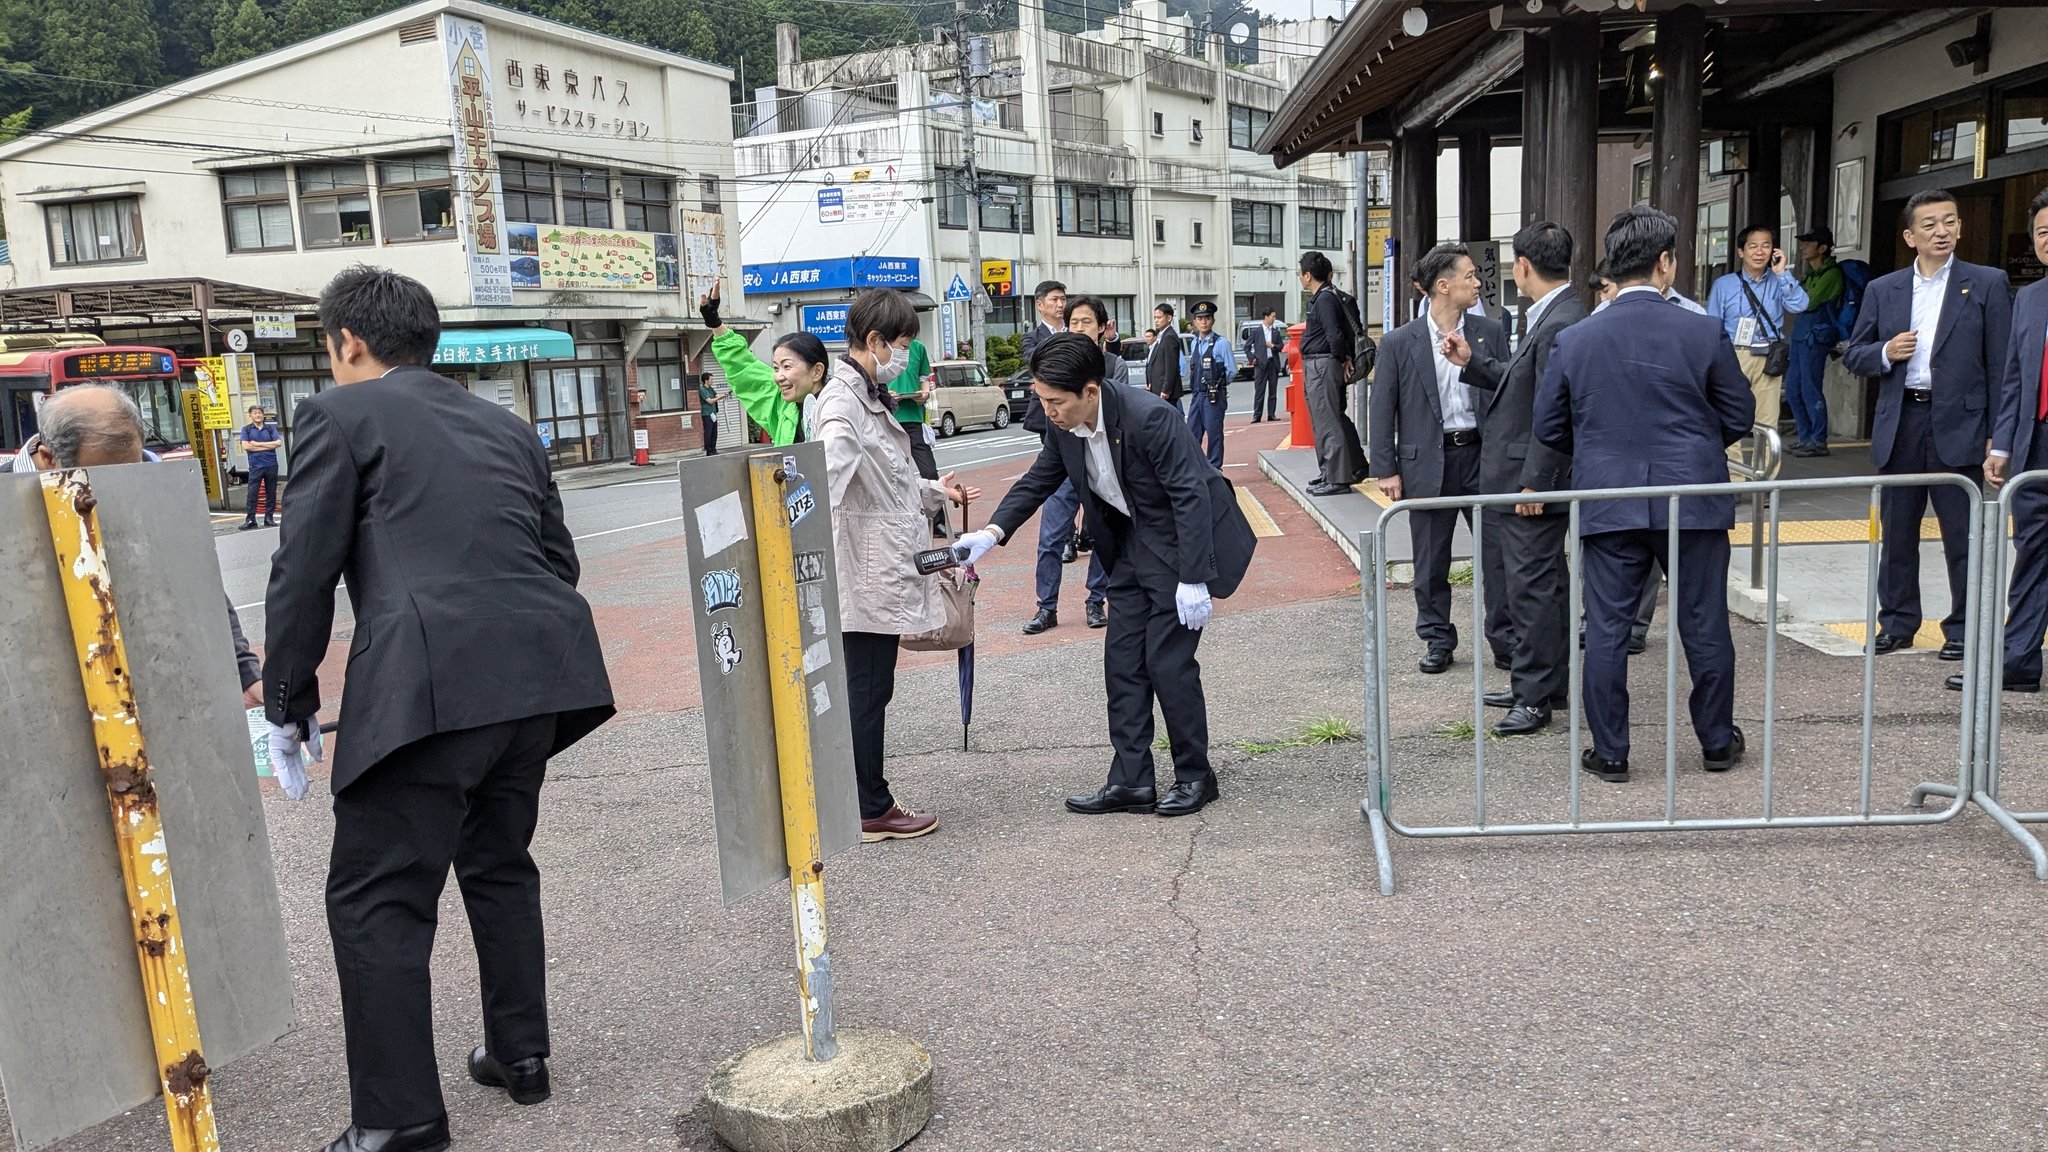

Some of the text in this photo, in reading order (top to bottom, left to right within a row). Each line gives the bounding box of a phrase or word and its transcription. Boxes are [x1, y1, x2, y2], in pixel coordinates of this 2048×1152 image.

[506, 58, 630, 107] 西東京バス
[517, 98, 650, 138] サービスステーション
[462, 75, 497, 250] 平山キャンプ場
[480, 265, 508, 274] 500名可能
[878, 262, 907, 270] JA西東京
[743, 269, 821, 287] 安心 JA西東京
[866, 274, 918, 283] キャッシュサービスコーナー
[1484, 247, 1496, 307] 気づいて
[1001, 282, 1011, 295] P
[815, 310, 847, 321] JA西東京
[233, 334, 243, 347] 2
[99, 353, 151, 368] 奥多摩湖
[920, 551, 946, 564] SECURITY
